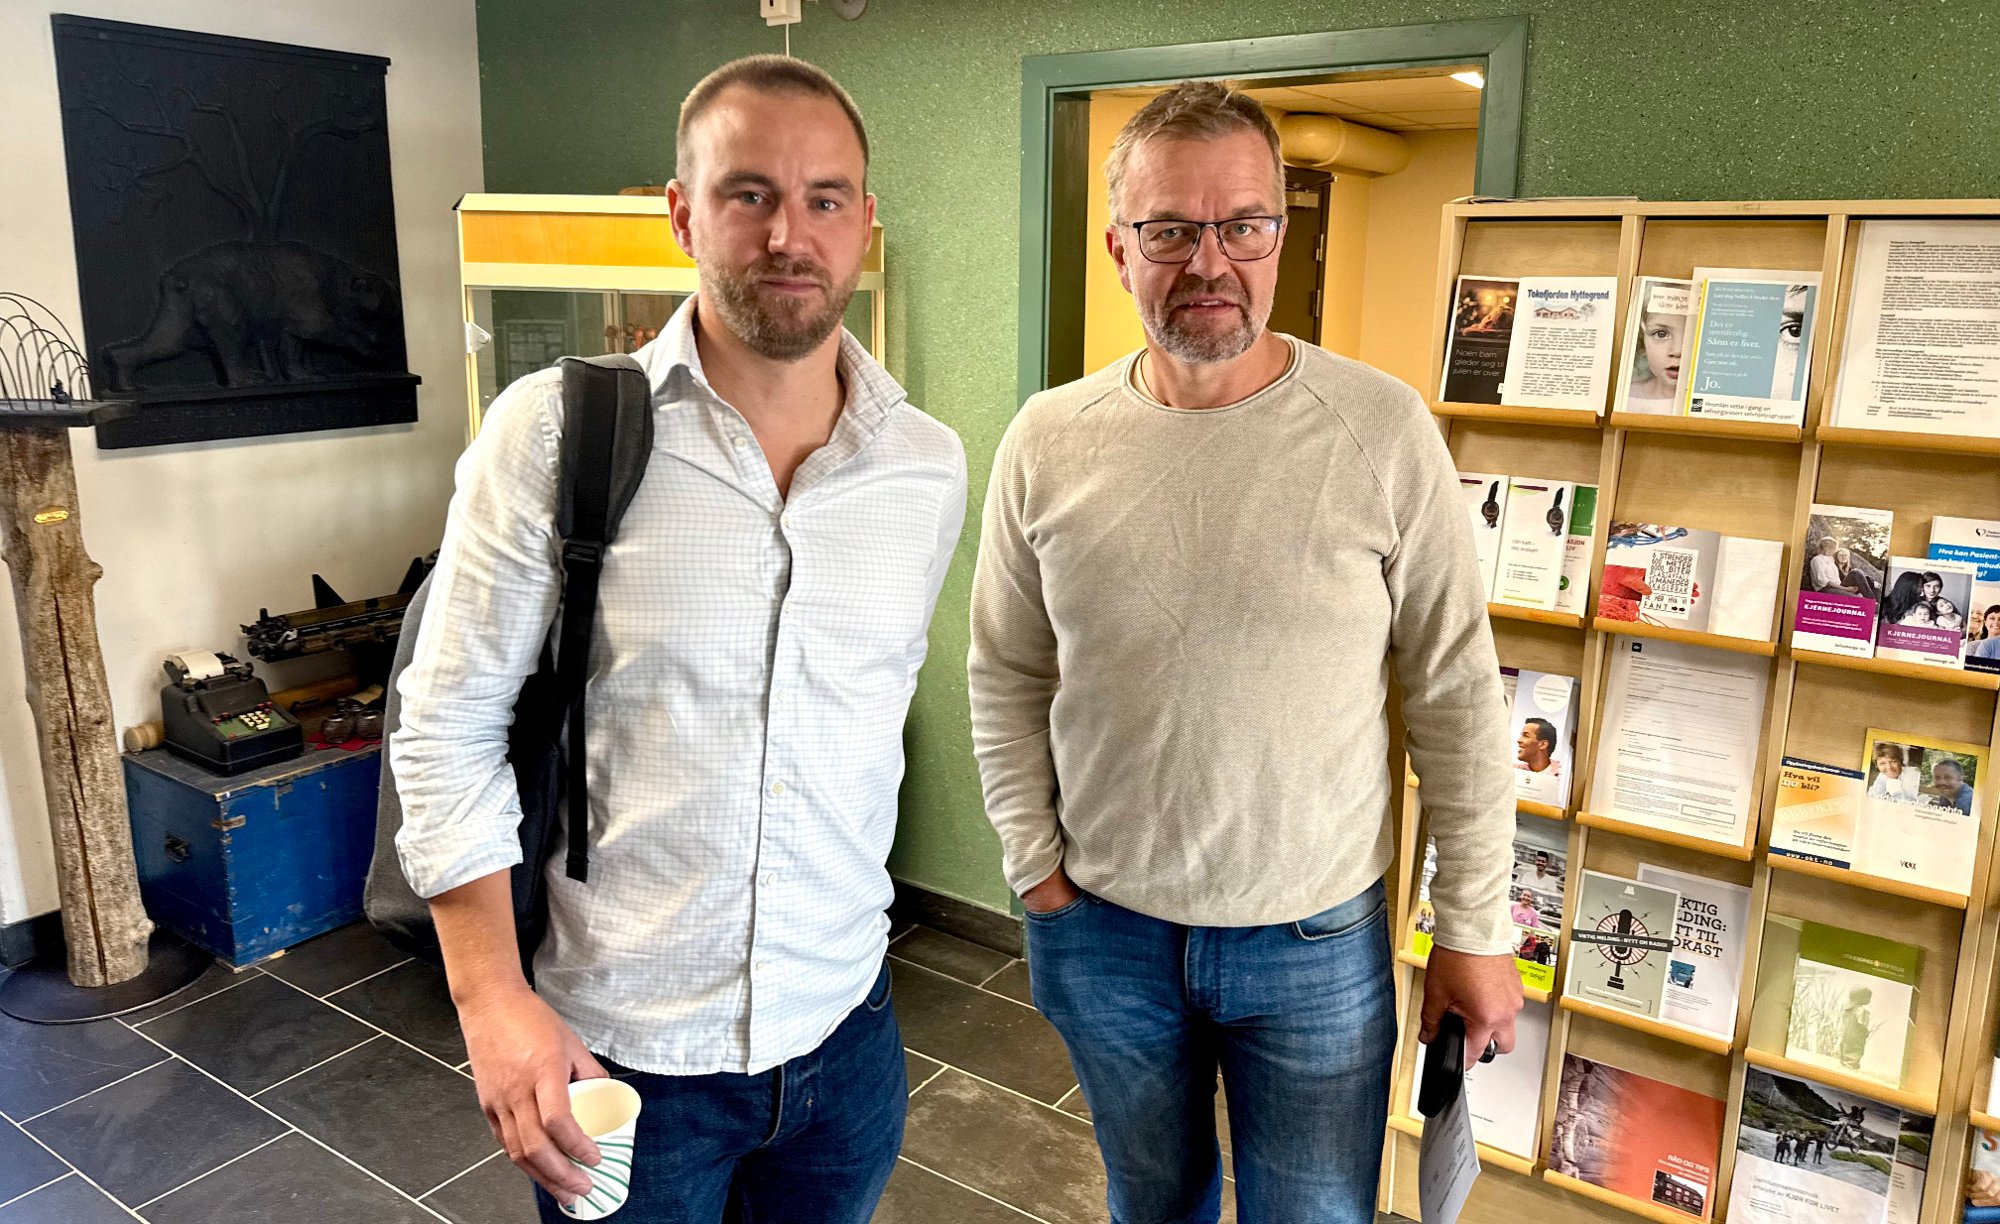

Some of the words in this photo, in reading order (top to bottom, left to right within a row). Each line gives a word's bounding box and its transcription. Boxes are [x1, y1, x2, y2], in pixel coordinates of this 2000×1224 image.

[1455, 349, 1478, 357] Noen
[1454, 358, 1479, 367] gleder
[1451, 367, 1472, 375] julen
[1700, 376, 1721, 391] Jo.
[1660, 552, 1693, 562] STRENDER
[1954, 549, 1969, 557] kan
[1666, 560, 1692, 568] METER
[1668, 566, 1691, 575] BITER
[1644, 601, 1668, 610] FANT
[1804, 604, 1866, 617] KJERNEJOURNAL
[1887, 630, 1952, 643] KJERNEJOURNAL
[1784, 771, 1805, 780] Hva
[1807, 775, 1820, 783] vil
[1801, 782, 1820, 791] bli?
[1679, 897, 1718, 916] KTIG
[1696, 928, 1719, 944] TIL
[1785, 1193, 1804, 1202] KJØR
[1805, 1197, 1819, 1206] FOR
[1820, 1202, 1840, 1213] LIVET
